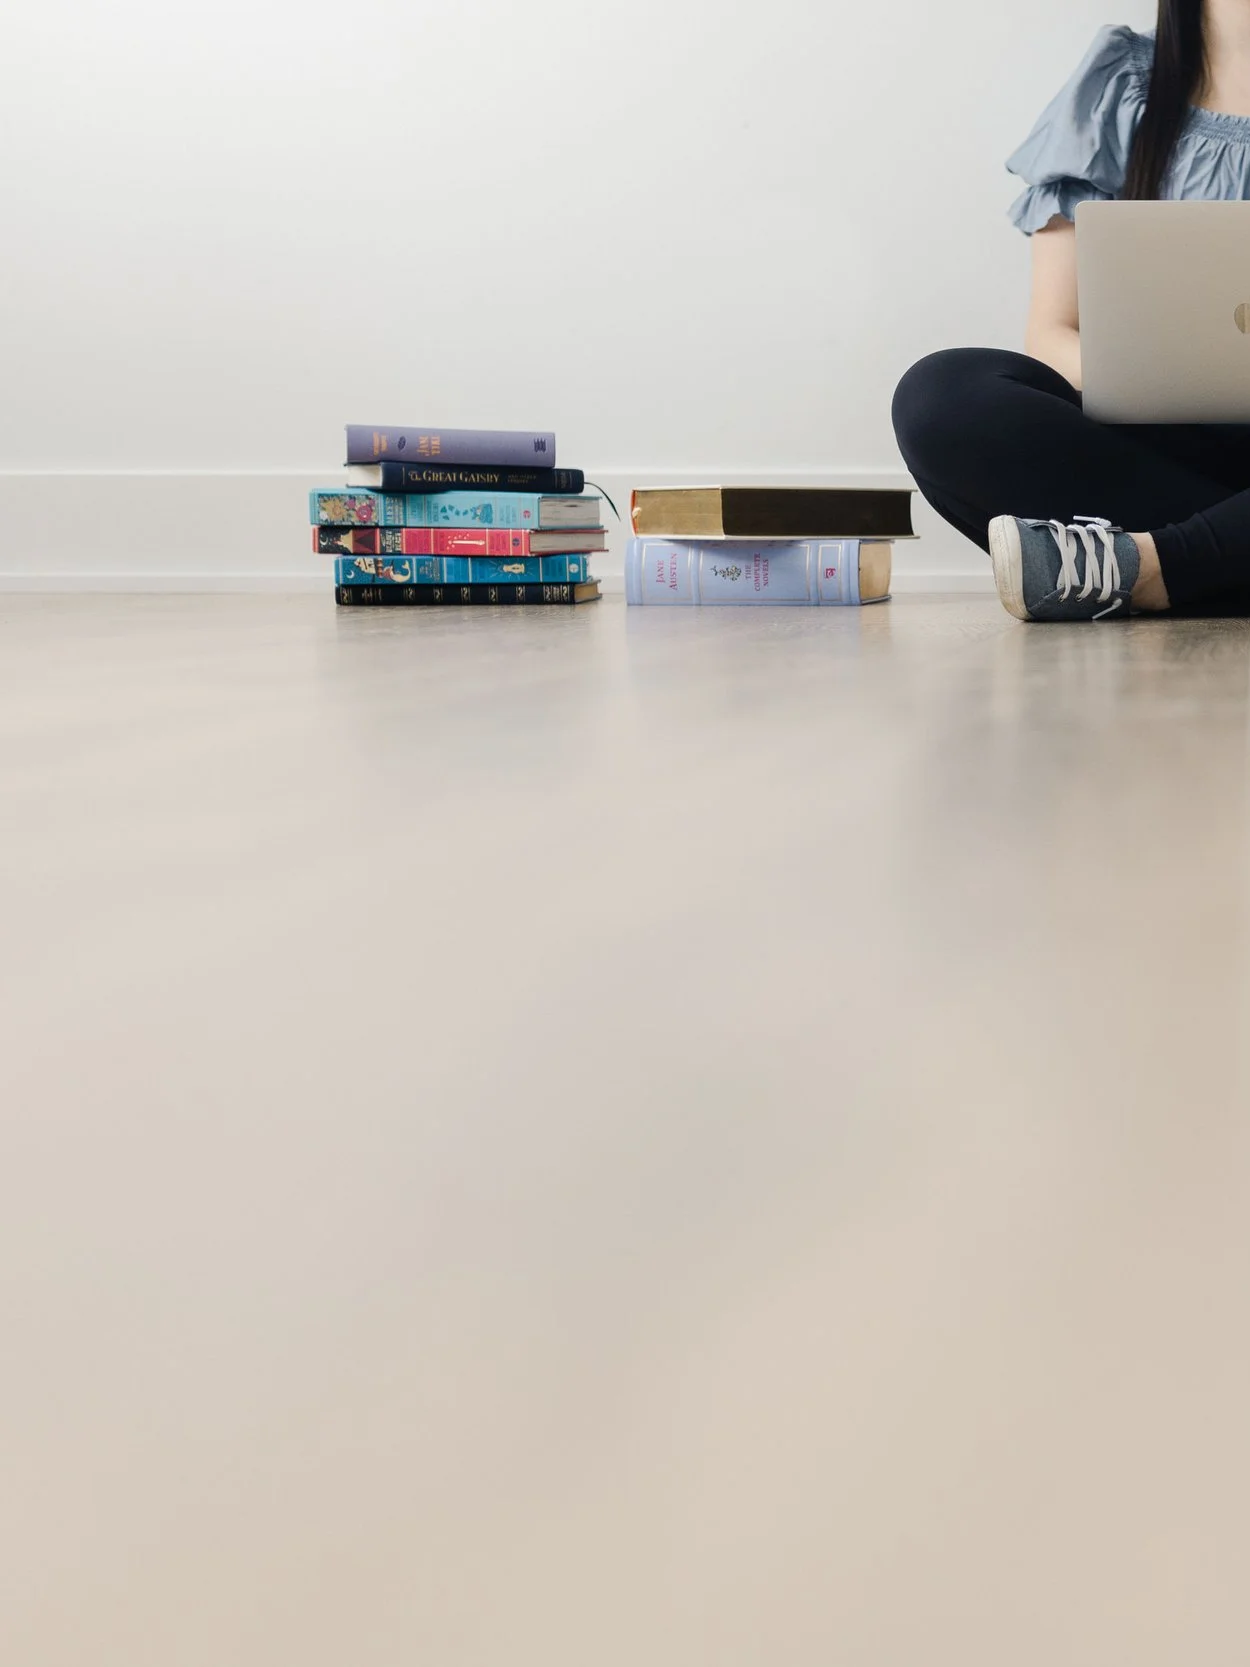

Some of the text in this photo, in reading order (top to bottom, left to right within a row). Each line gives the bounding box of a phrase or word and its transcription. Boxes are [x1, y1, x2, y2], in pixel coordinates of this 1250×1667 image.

[422, 469, 457, 484] GREAT
[459, 470, 500, 484] GATSBY
[656, 559, 665, 583] JANE
[668, 553, 678, 591] AUSTEN
[753, 552, 761, 591] COMPLETE
